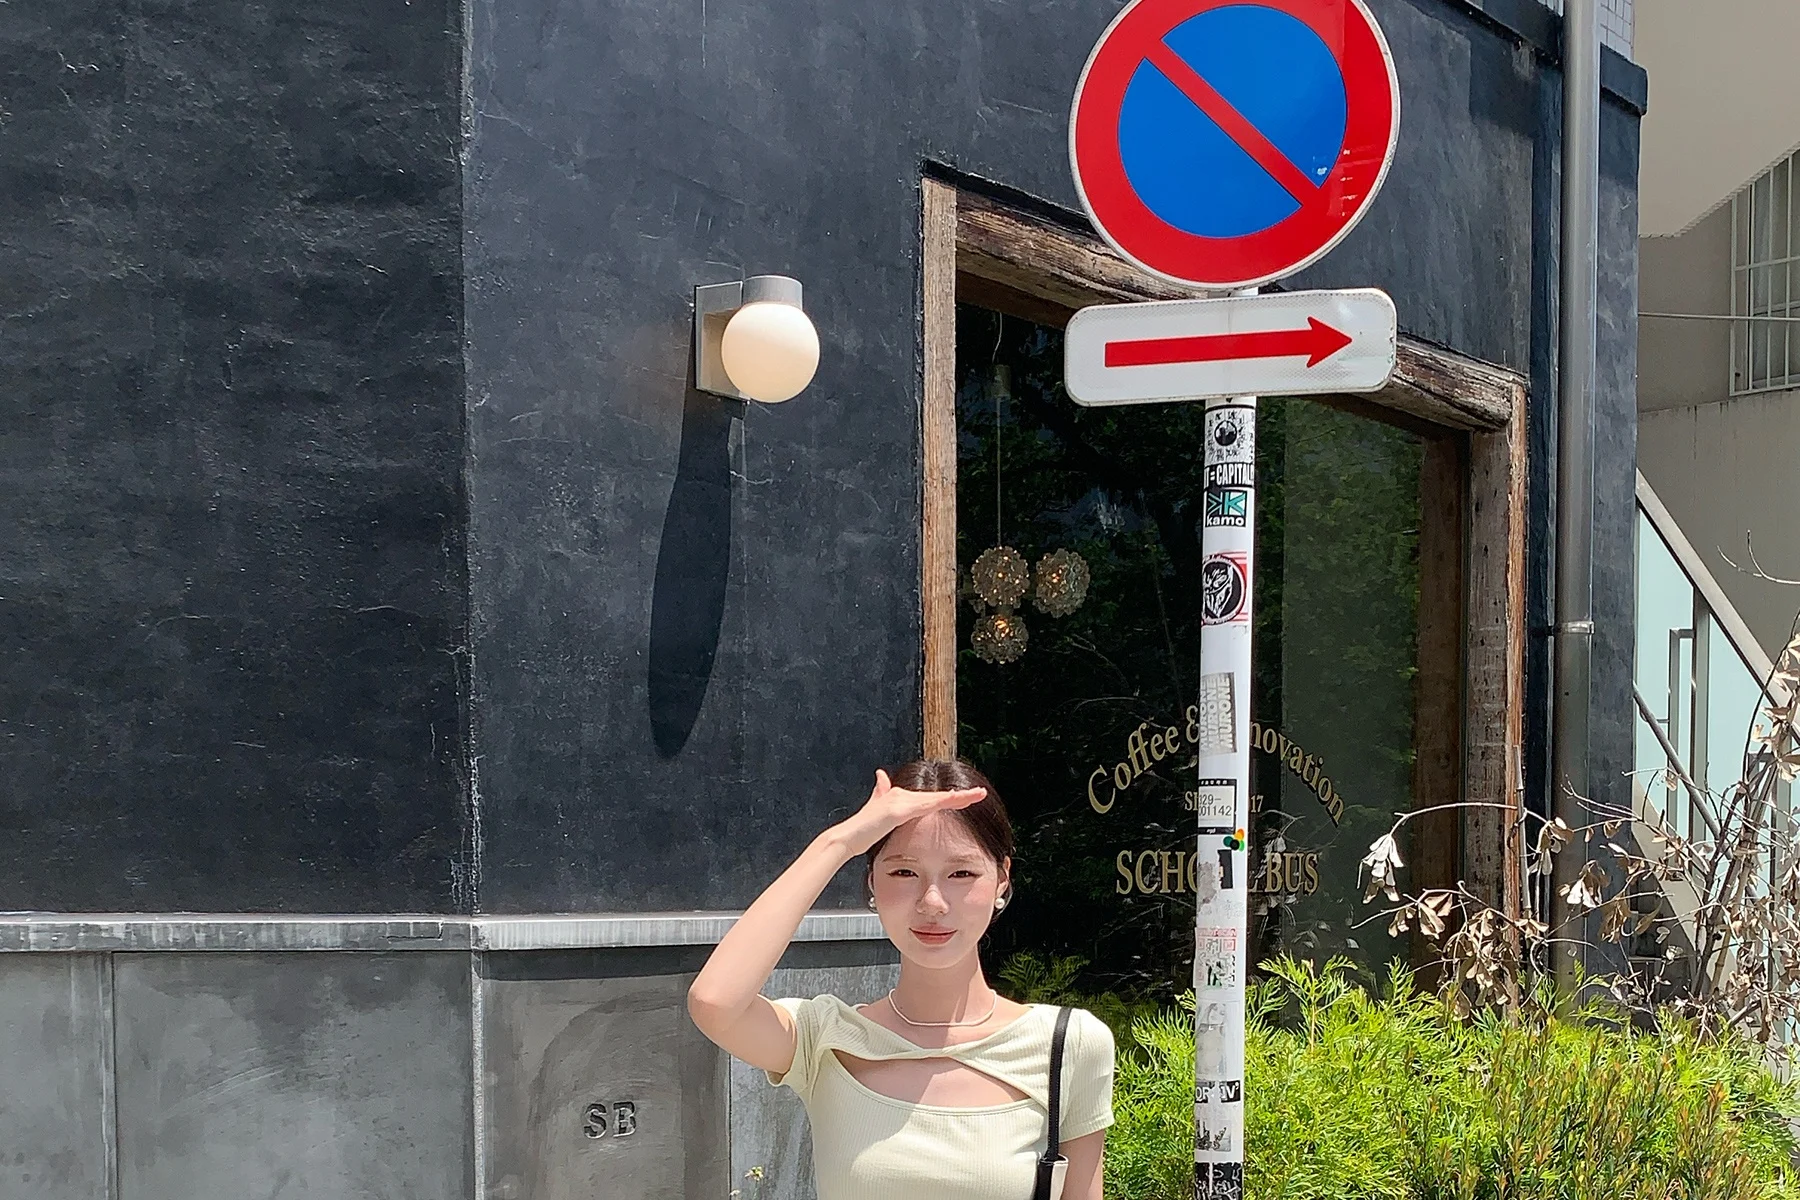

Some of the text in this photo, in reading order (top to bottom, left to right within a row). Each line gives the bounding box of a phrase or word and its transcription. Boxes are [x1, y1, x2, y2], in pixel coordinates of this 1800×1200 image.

[1206, 512, 1245, 527] kamo
[1087, 721, 1180, 814] Coffee
[1264, 852, 1320, 894] BUS
[583, 1101, 637, 1139] SB
